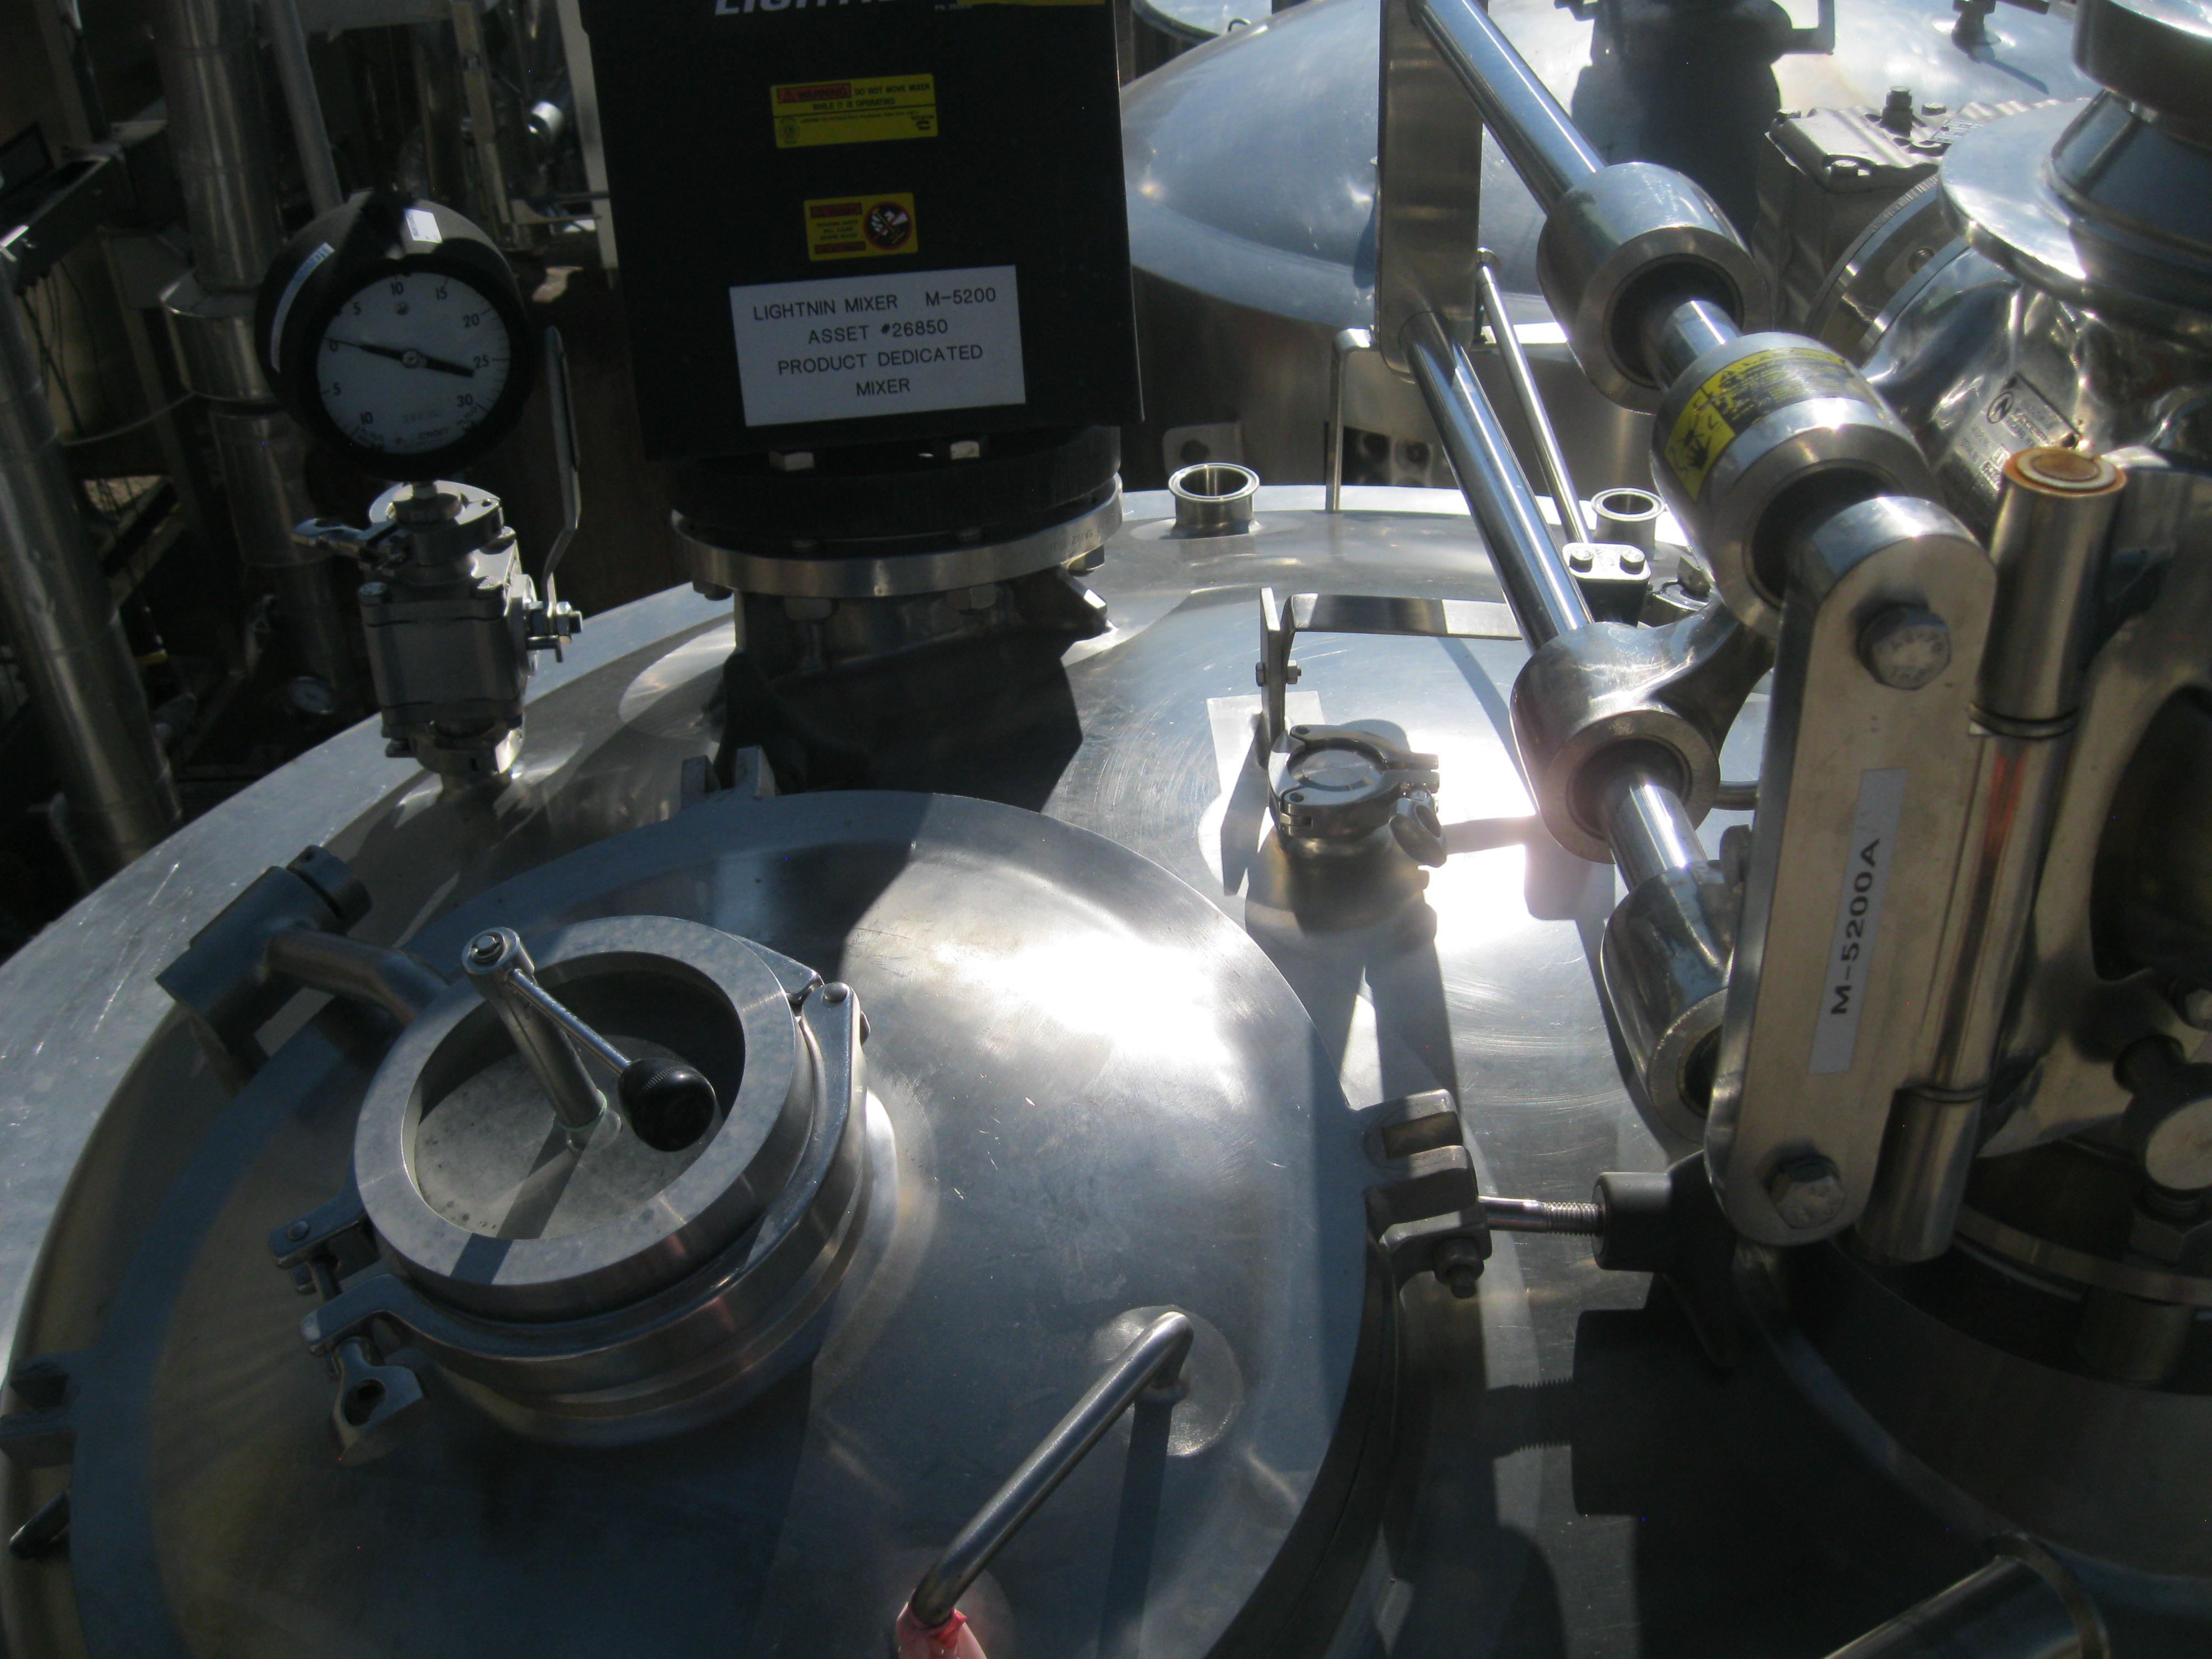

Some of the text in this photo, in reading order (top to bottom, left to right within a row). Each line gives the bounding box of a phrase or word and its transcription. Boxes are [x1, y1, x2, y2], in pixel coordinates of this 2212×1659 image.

[868, 86, 883, 95] NOT
[885, 85, 906, 93] MOVE
[812, 102, 834, 110] WHILE
[855, 97, 896, 107] OPERATING
[390, 281, 404, 296] 10
[435, 285, 448, 300] 15
[353, 301, 362, 316] 5
[753, 286, 997, 321] LIGHTNIN MIXER M-5200
[463, 312, 480, 328] 20
[807, 318, 948, 345] ASSET #26850
[328, 338, 338, 352] 0
[473, 354, 489, 369] 25
[778, 343, 984, 375] PRODUCT DEDICATED
[332, 382, 341, 395] 5
[856, 378, 911, 397] MIXER
[456, 393, 473, 408] 30
[359, 411, 374, 425] 10
[1830, 837, 1881, 1015] M-5200A
